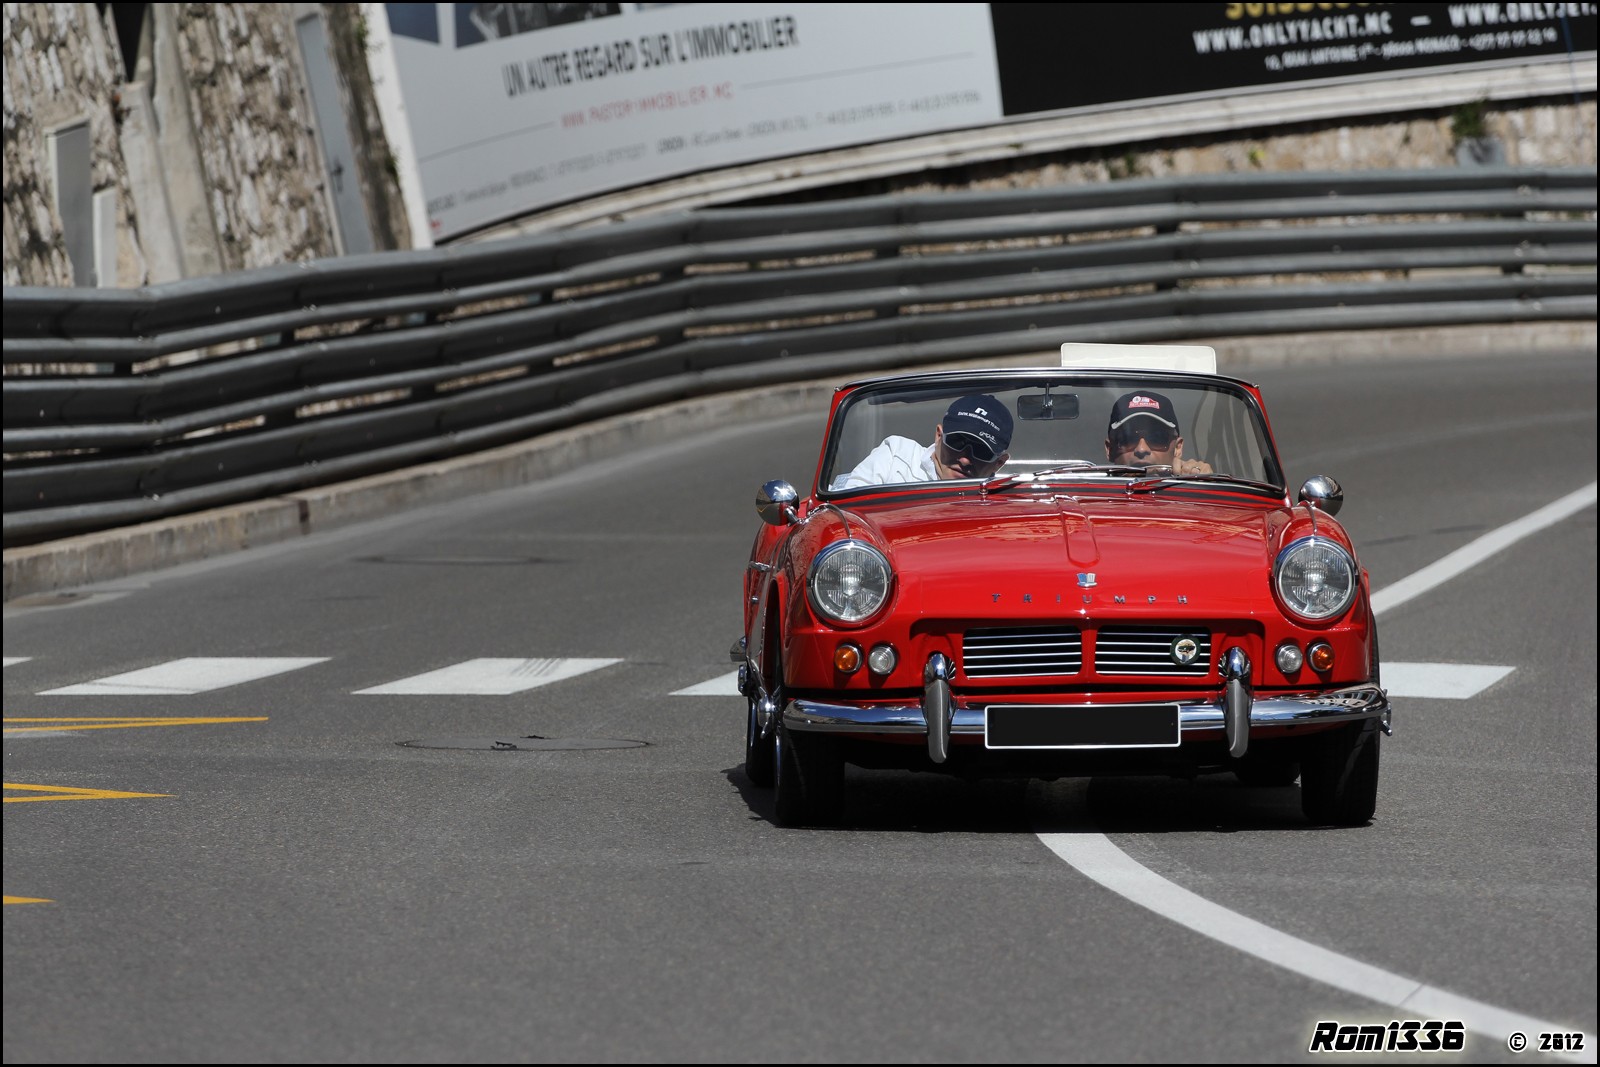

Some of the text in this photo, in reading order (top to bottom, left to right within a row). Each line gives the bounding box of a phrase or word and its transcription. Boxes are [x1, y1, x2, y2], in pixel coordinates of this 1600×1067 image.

[1192, 11, 1394, 54] WWW.ONLYYACHT.MC
[502, 15, 800, 98] UN AUTRE REGARD SUR L'IMMOBILIER
[991, 593, 1188, 605] TRIUMPH
